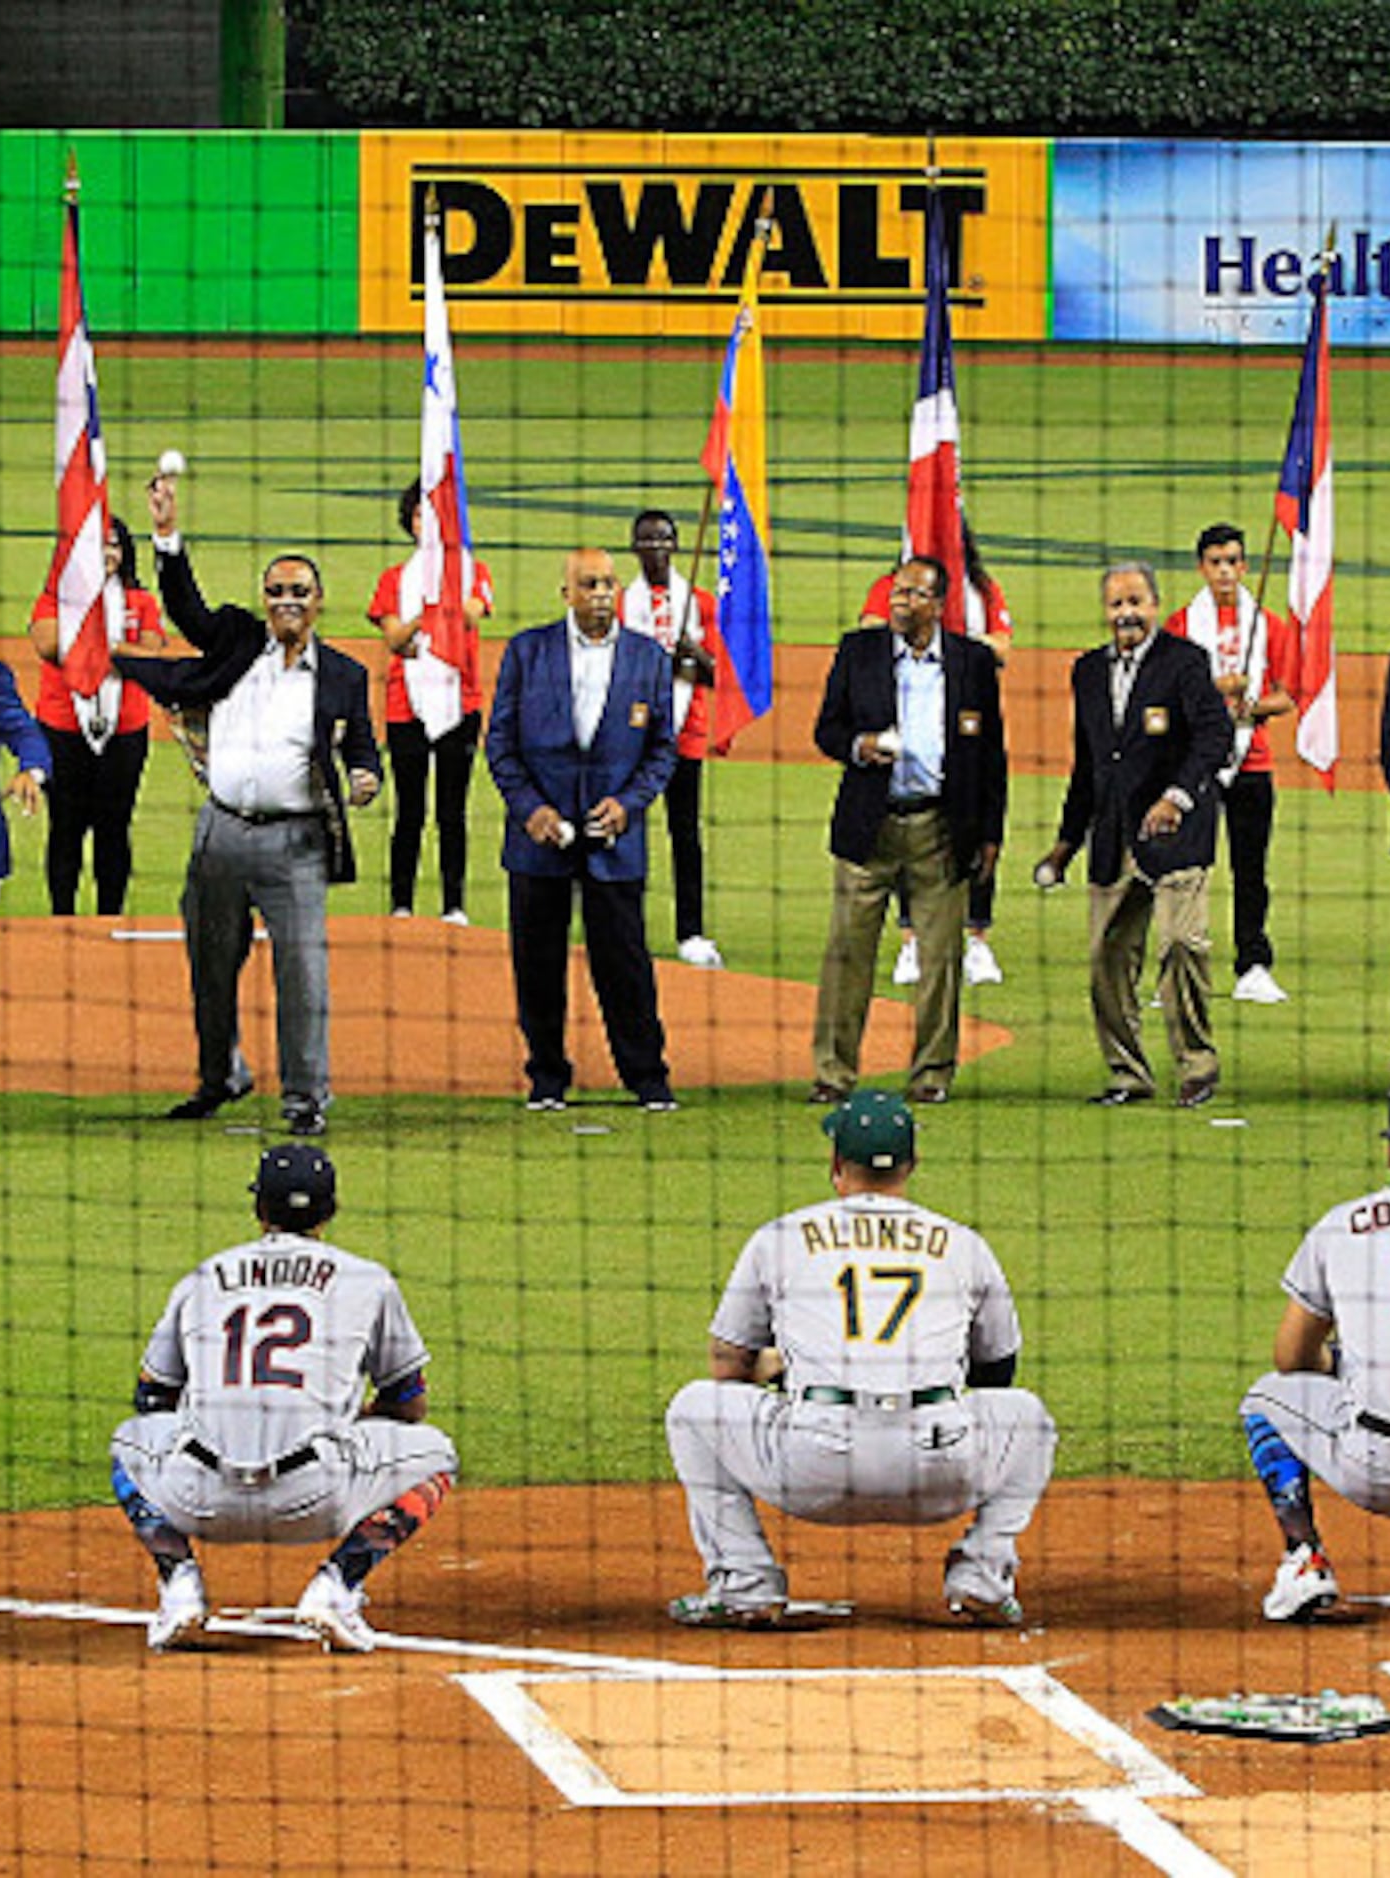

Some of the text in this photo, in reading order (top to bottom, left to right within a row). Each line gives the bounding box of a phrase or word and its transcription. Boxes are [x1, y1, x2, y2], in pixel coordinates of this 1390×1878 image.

[800, 1214, 950, 1259] ALONSO
[213, 1254, 337, 1293] LINDOR
[835, 1261, 926, 1345] 17
[222, 1302, 313, 1389] 12
